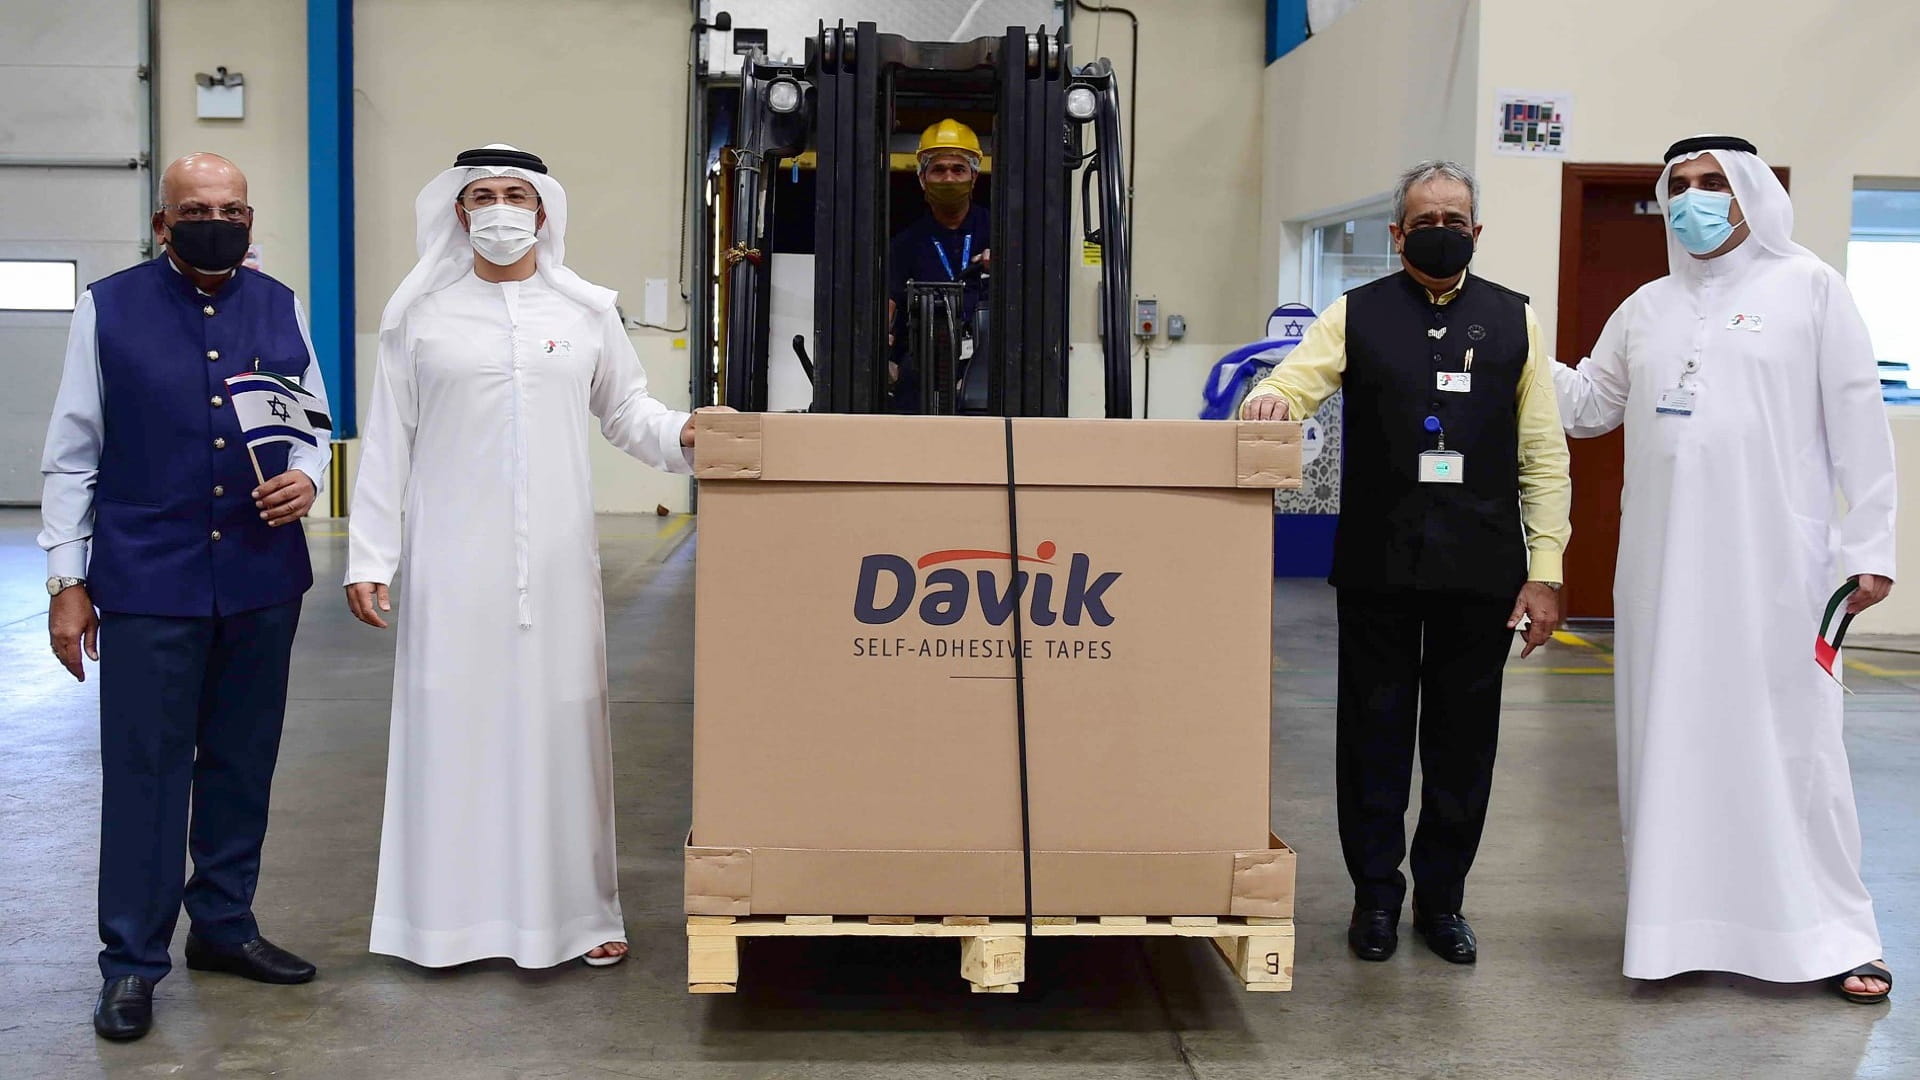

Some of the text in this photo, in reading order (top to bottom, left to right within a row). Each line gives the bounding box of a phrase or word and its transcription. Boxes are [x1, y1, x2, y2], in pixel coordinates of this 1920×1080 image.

[853, 540, 1123, 627] Davik
[853, 637, 1112, 660] SELF-ADHESIVE TAPES
